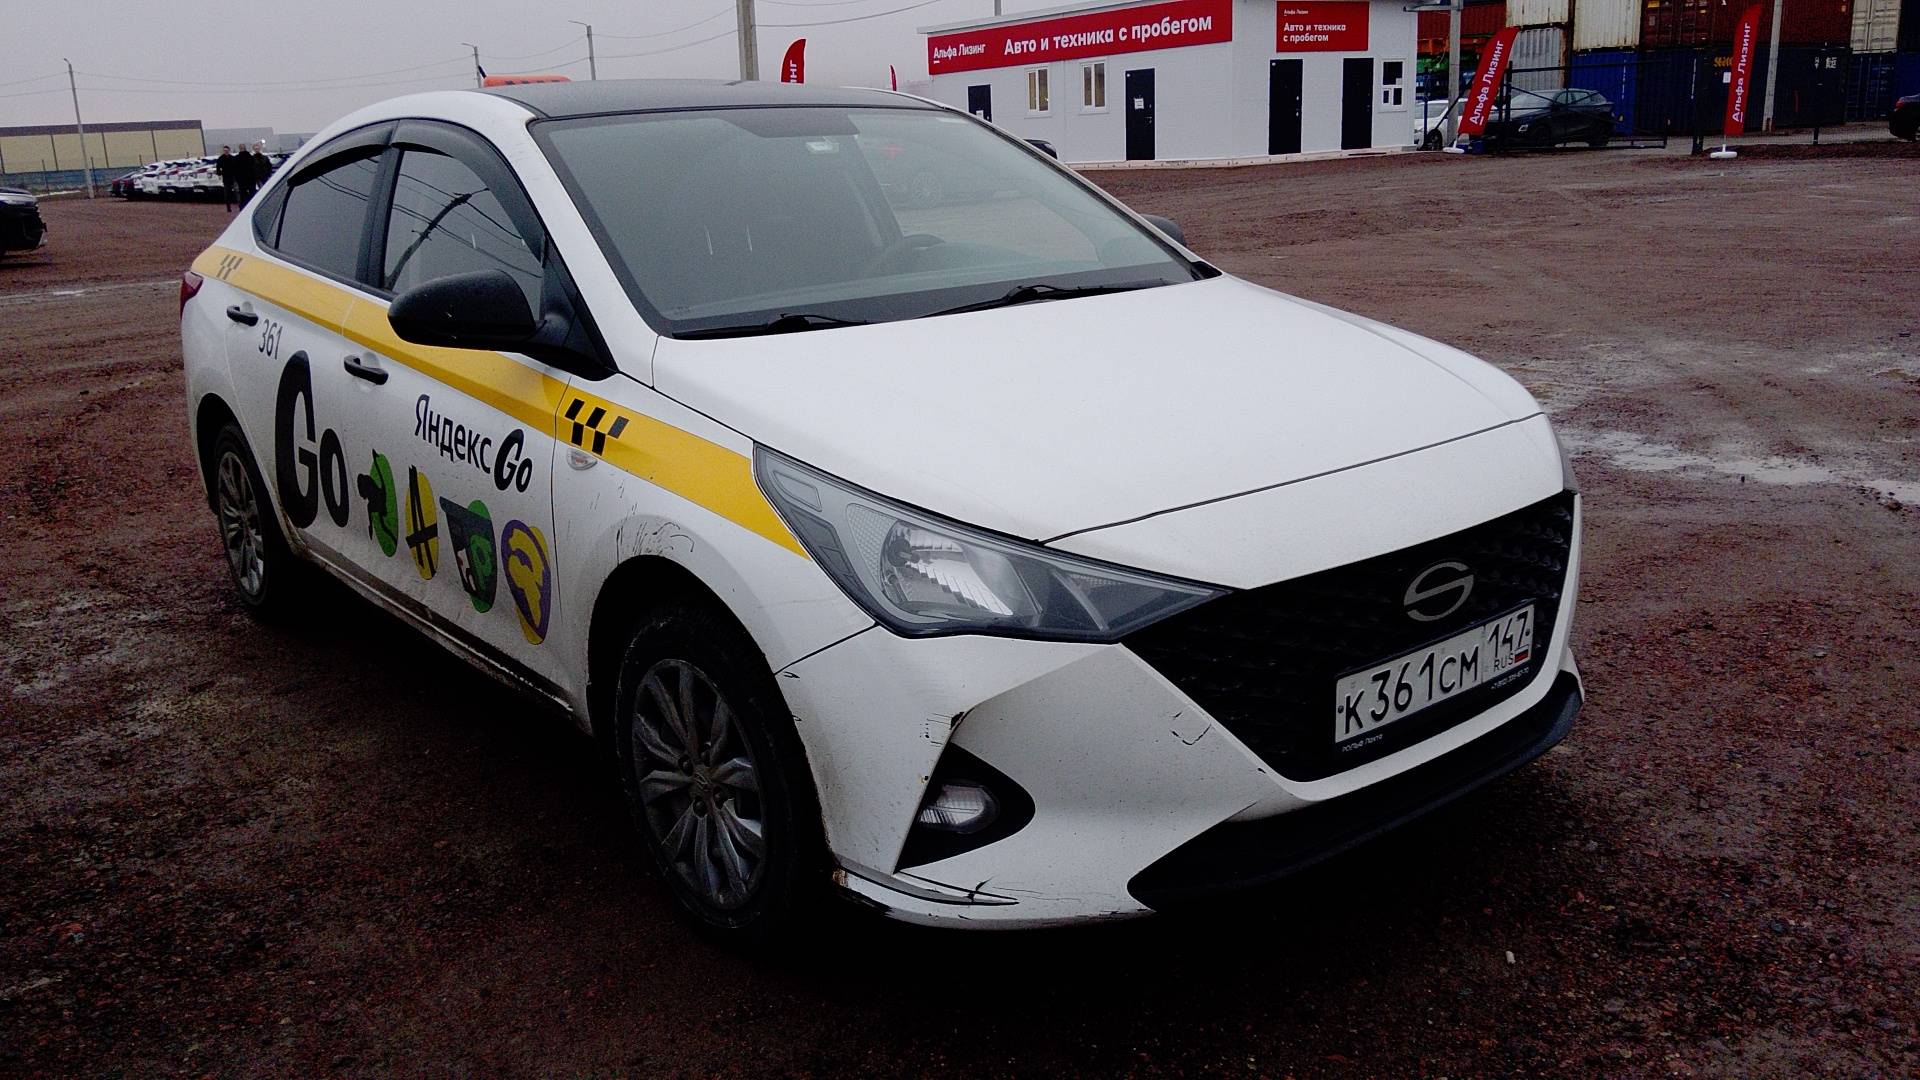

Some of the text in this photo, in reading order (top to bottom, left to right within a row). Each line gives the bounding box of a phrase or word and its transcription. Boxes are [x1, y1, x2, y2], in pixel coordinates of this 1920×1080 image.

[1004, 13, 1213, 56] Авто и техника с пробегом
[1284, 22, 1304, 31] Авто
[1289, 33, 1329, 44] пробегом
[933, 43, 987, 60] Альфа Лизинг
[1731, 22, 1751, 123] Альфа Лизинг
[1469, 40, 1506, 125] Альфа Лизинг
[257, 317, 283, 361] 361
[274, 349, 350, 529] Go
[414, 393, 534, 493] Яндекс Go
[1488, 611, 1528, 659] 147
[1493, 651, 1515, 673] RUS
